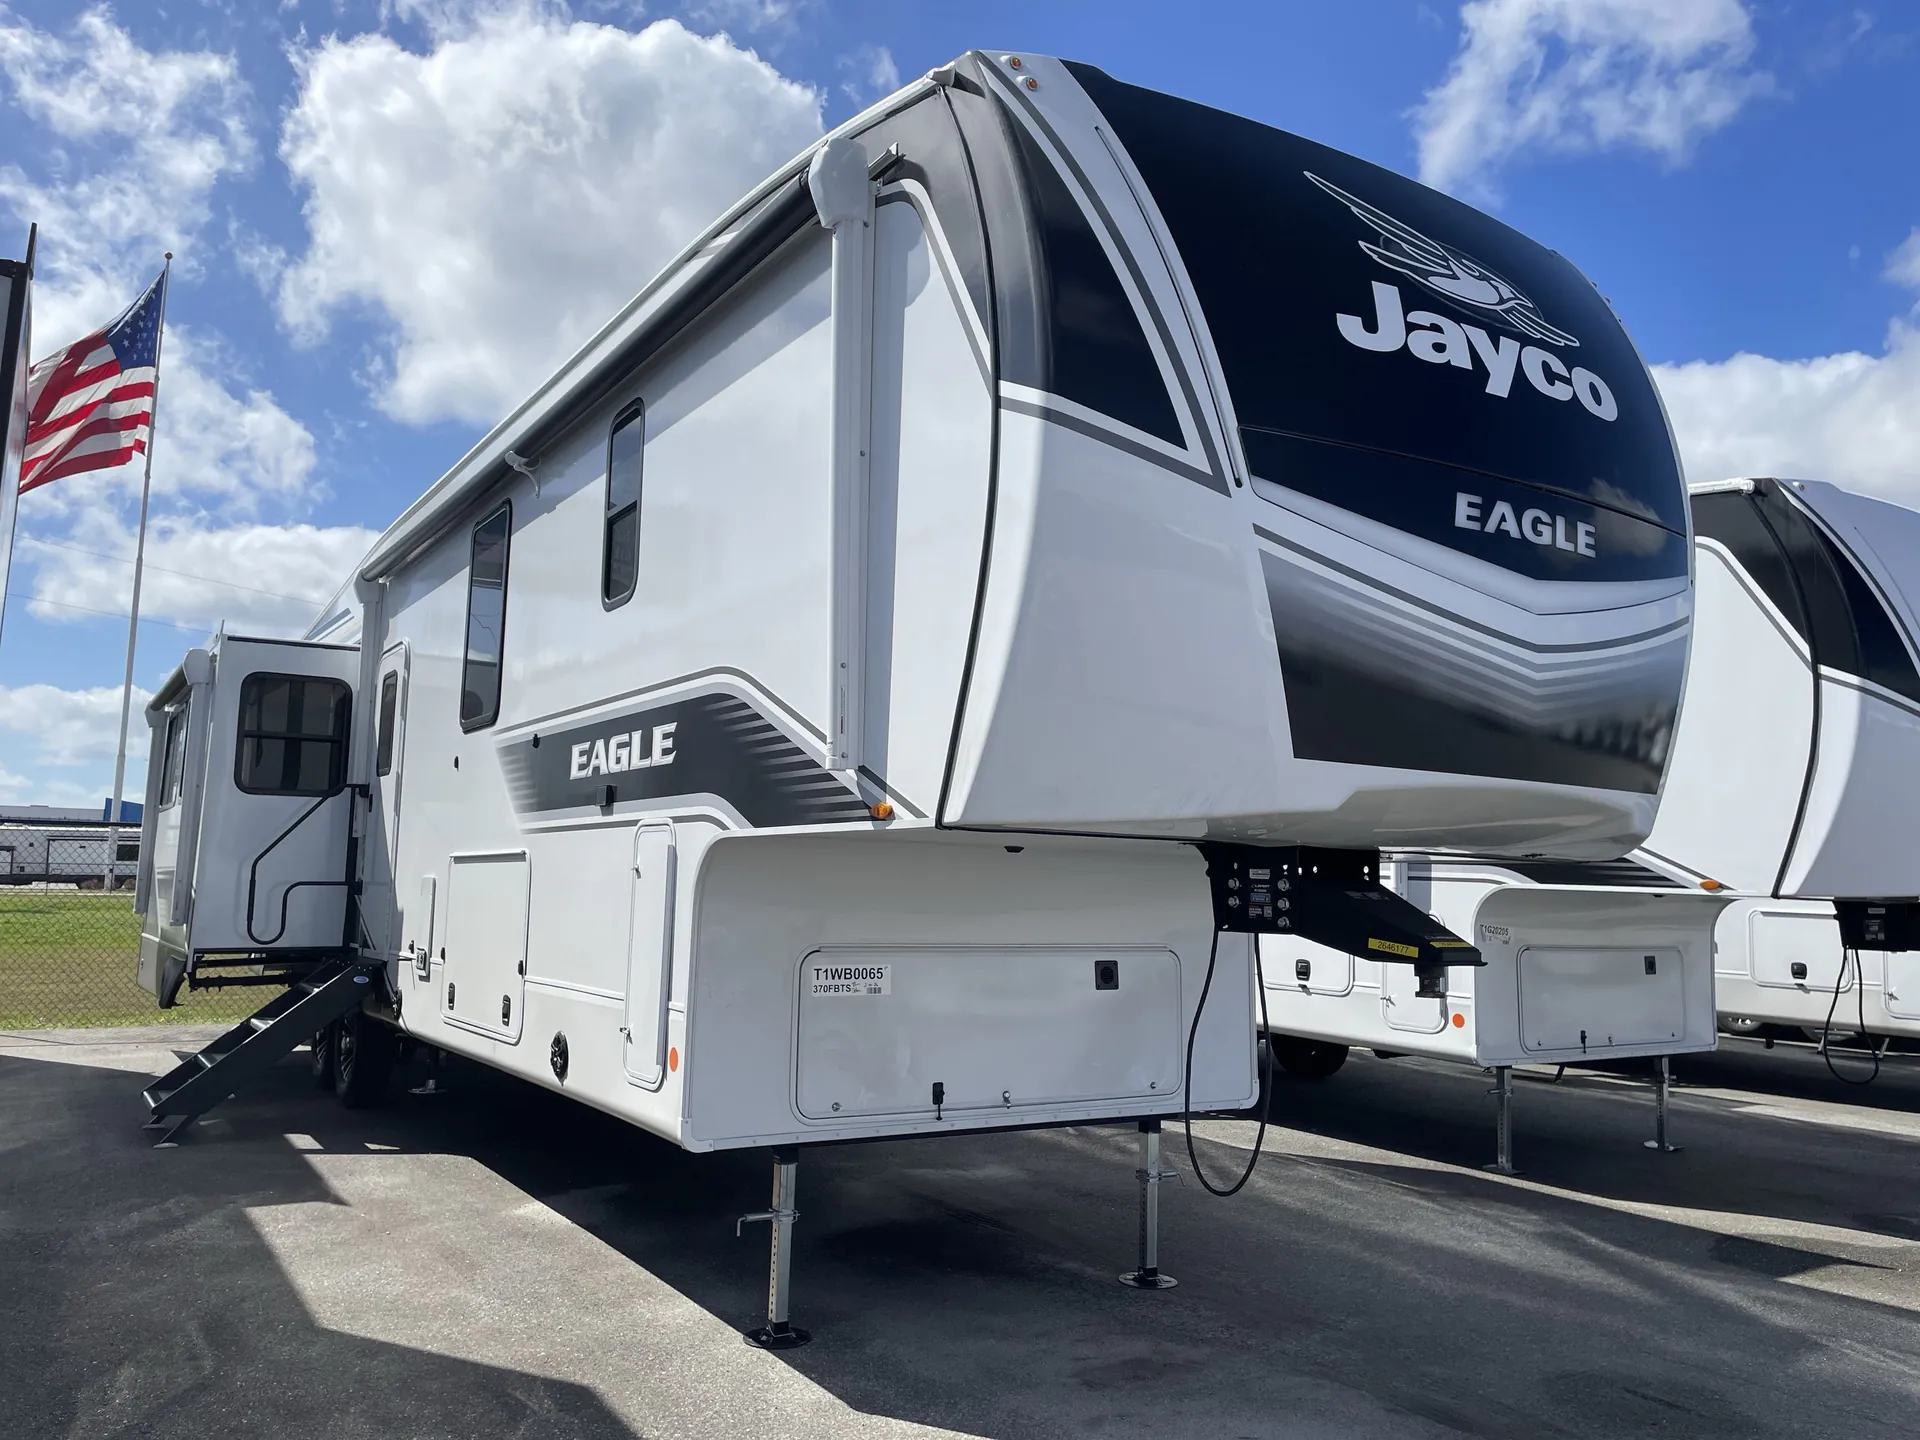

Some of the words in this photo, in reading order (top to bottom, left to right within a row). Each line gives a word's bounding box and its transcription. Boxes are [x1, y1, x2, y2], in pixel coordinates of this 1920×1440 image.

[1336, 280, 1617, 422] Jayco
[1454, 491, 1596, 558] EAGLE
[569, 721, 678, 780] EAGLE
[1377, 941, 1409, 954] 2646177
[813, 967, 883, 981] T1WB0065
[813, 984, 852, 994] 370FBTS
